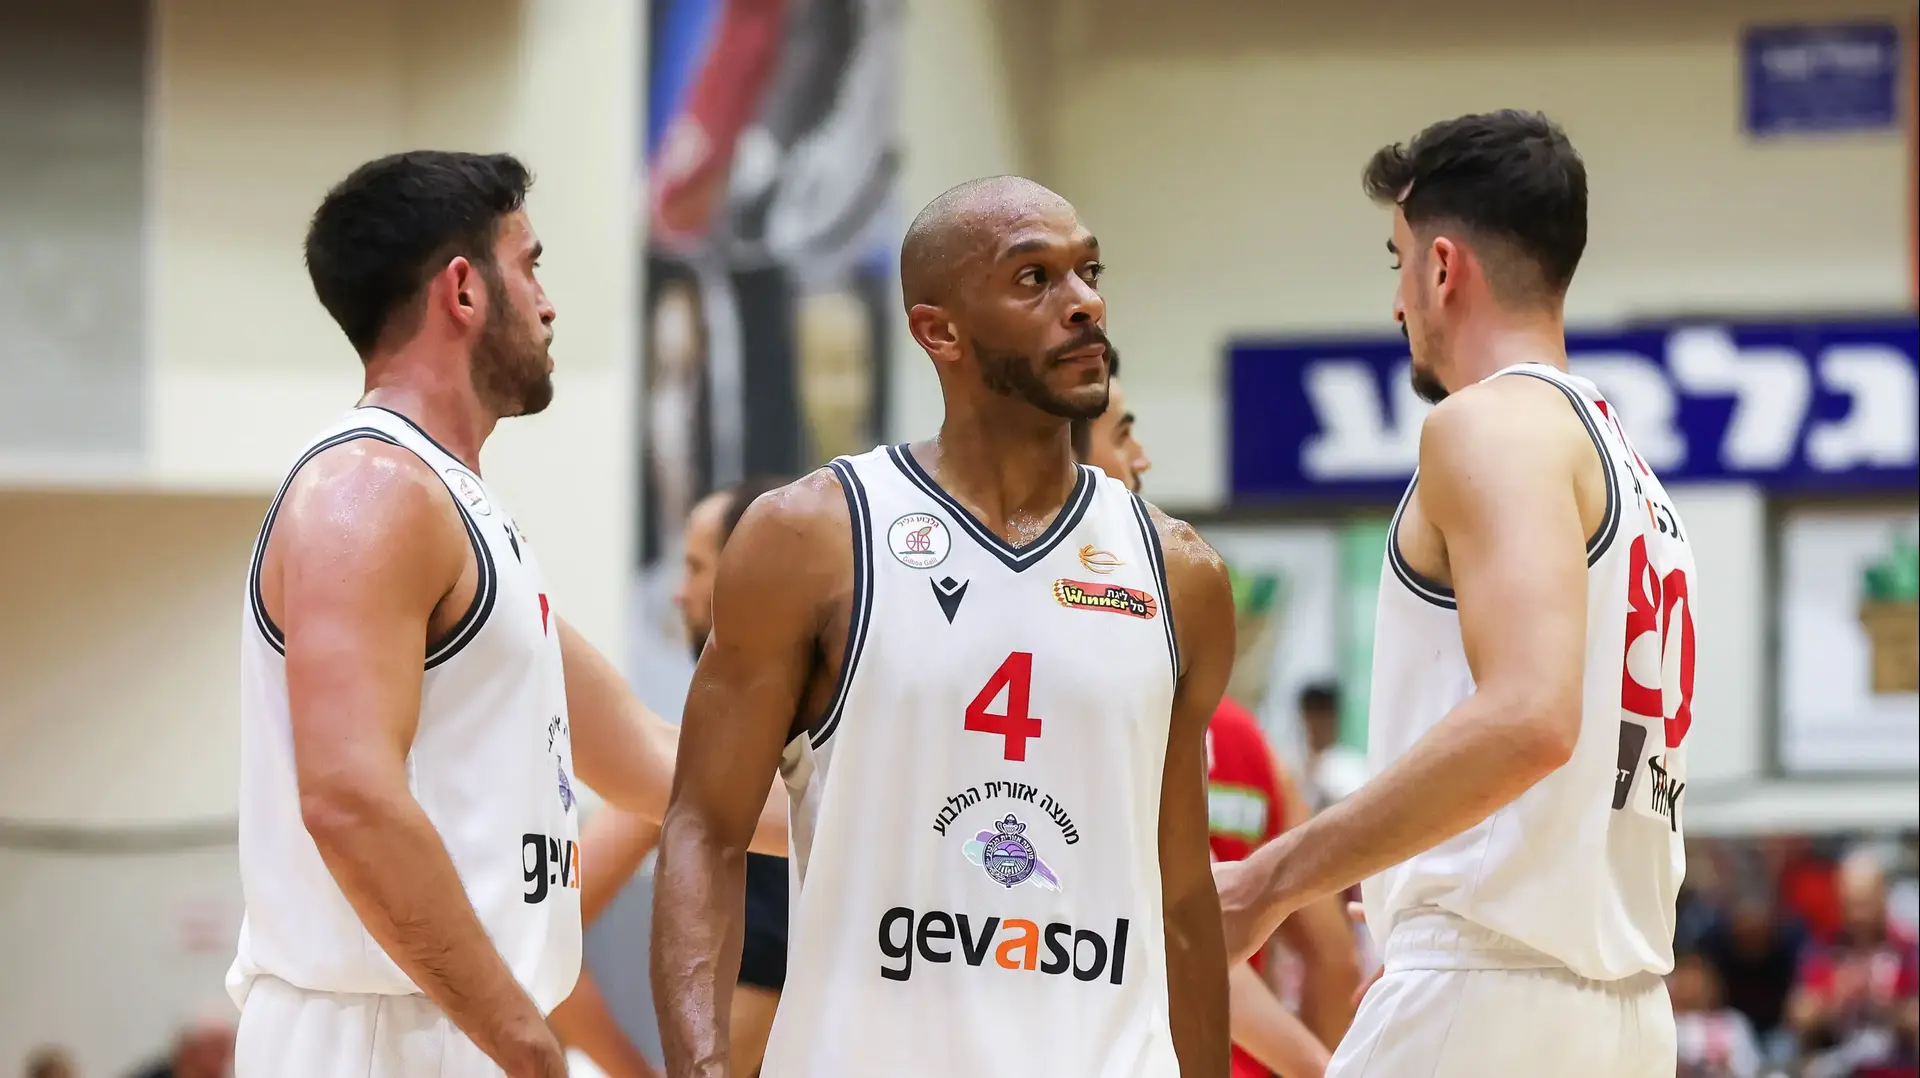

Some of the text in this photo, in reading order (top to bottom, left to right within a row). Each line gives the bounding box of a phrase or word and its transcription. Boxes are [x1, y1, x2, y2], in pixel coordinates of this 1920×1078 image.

[1299, 326, 1918, 474] גלבע
[1107, 589, 1129, 600] ליגת
[1130, 599, 1145, 613] סל
[964, 651, 1042, 761] 4
[932, 781, 1080, 845] מועצה אזורית הגלבוע
[878, 906, 1129, 985] gevasol
